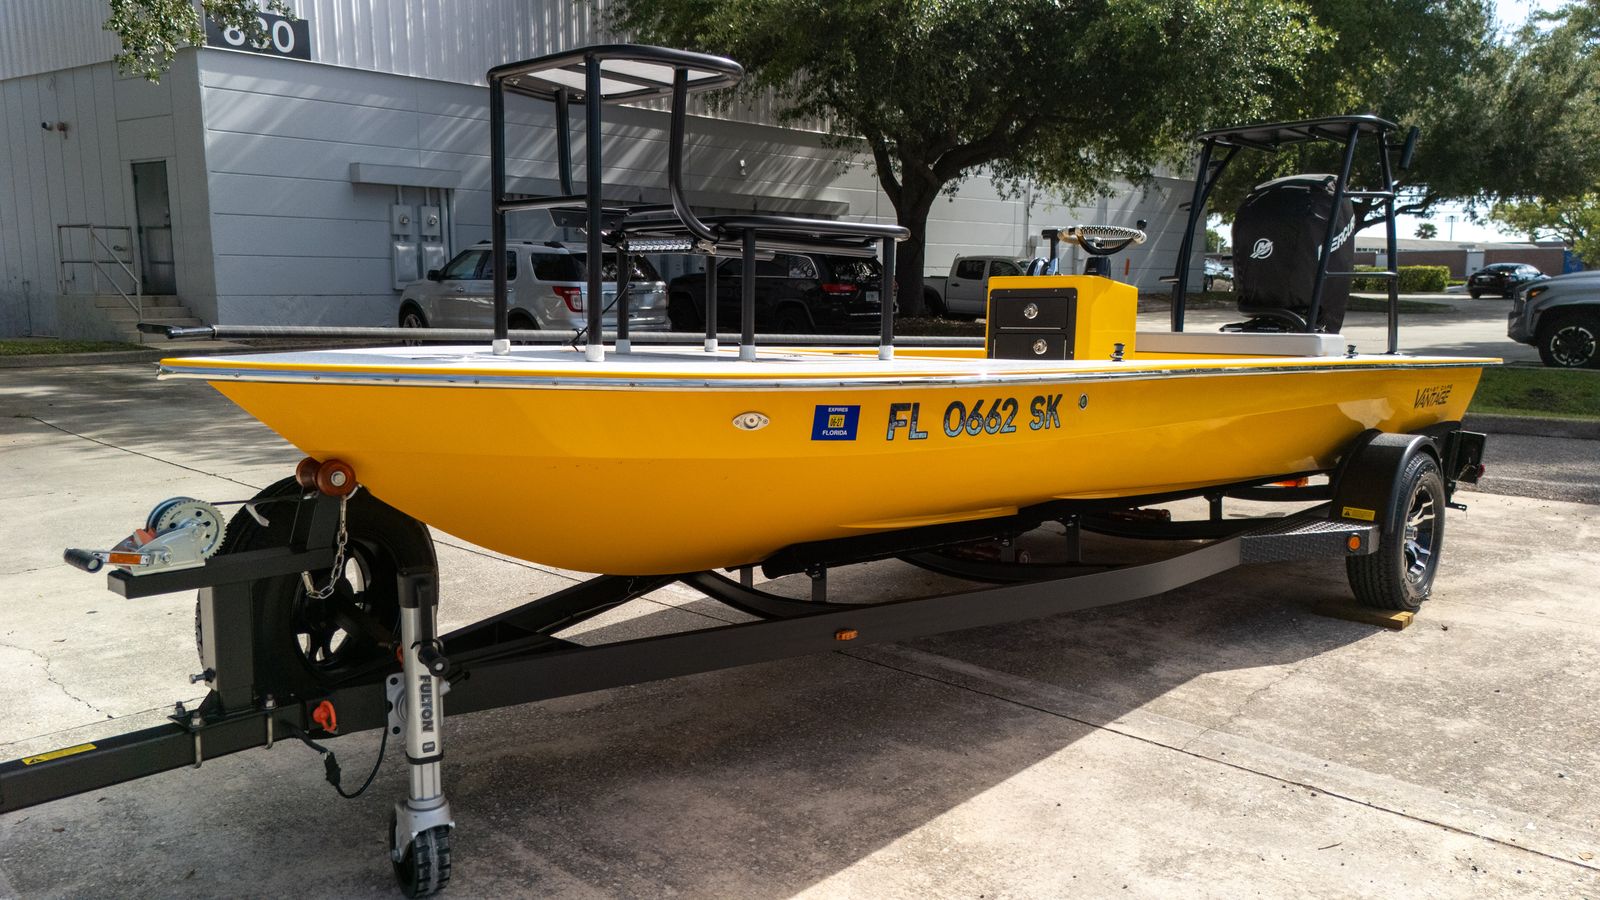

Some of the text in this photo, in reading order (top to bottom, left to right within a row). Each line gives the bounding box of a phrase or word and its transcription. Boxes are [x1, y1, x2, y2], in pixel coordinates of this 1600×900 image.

[886, 394, 1063, 440] FL 0662 SK
[1414, 388, 1451, 408] VANTAGE
[420, 675, 434, 732] FULTON
